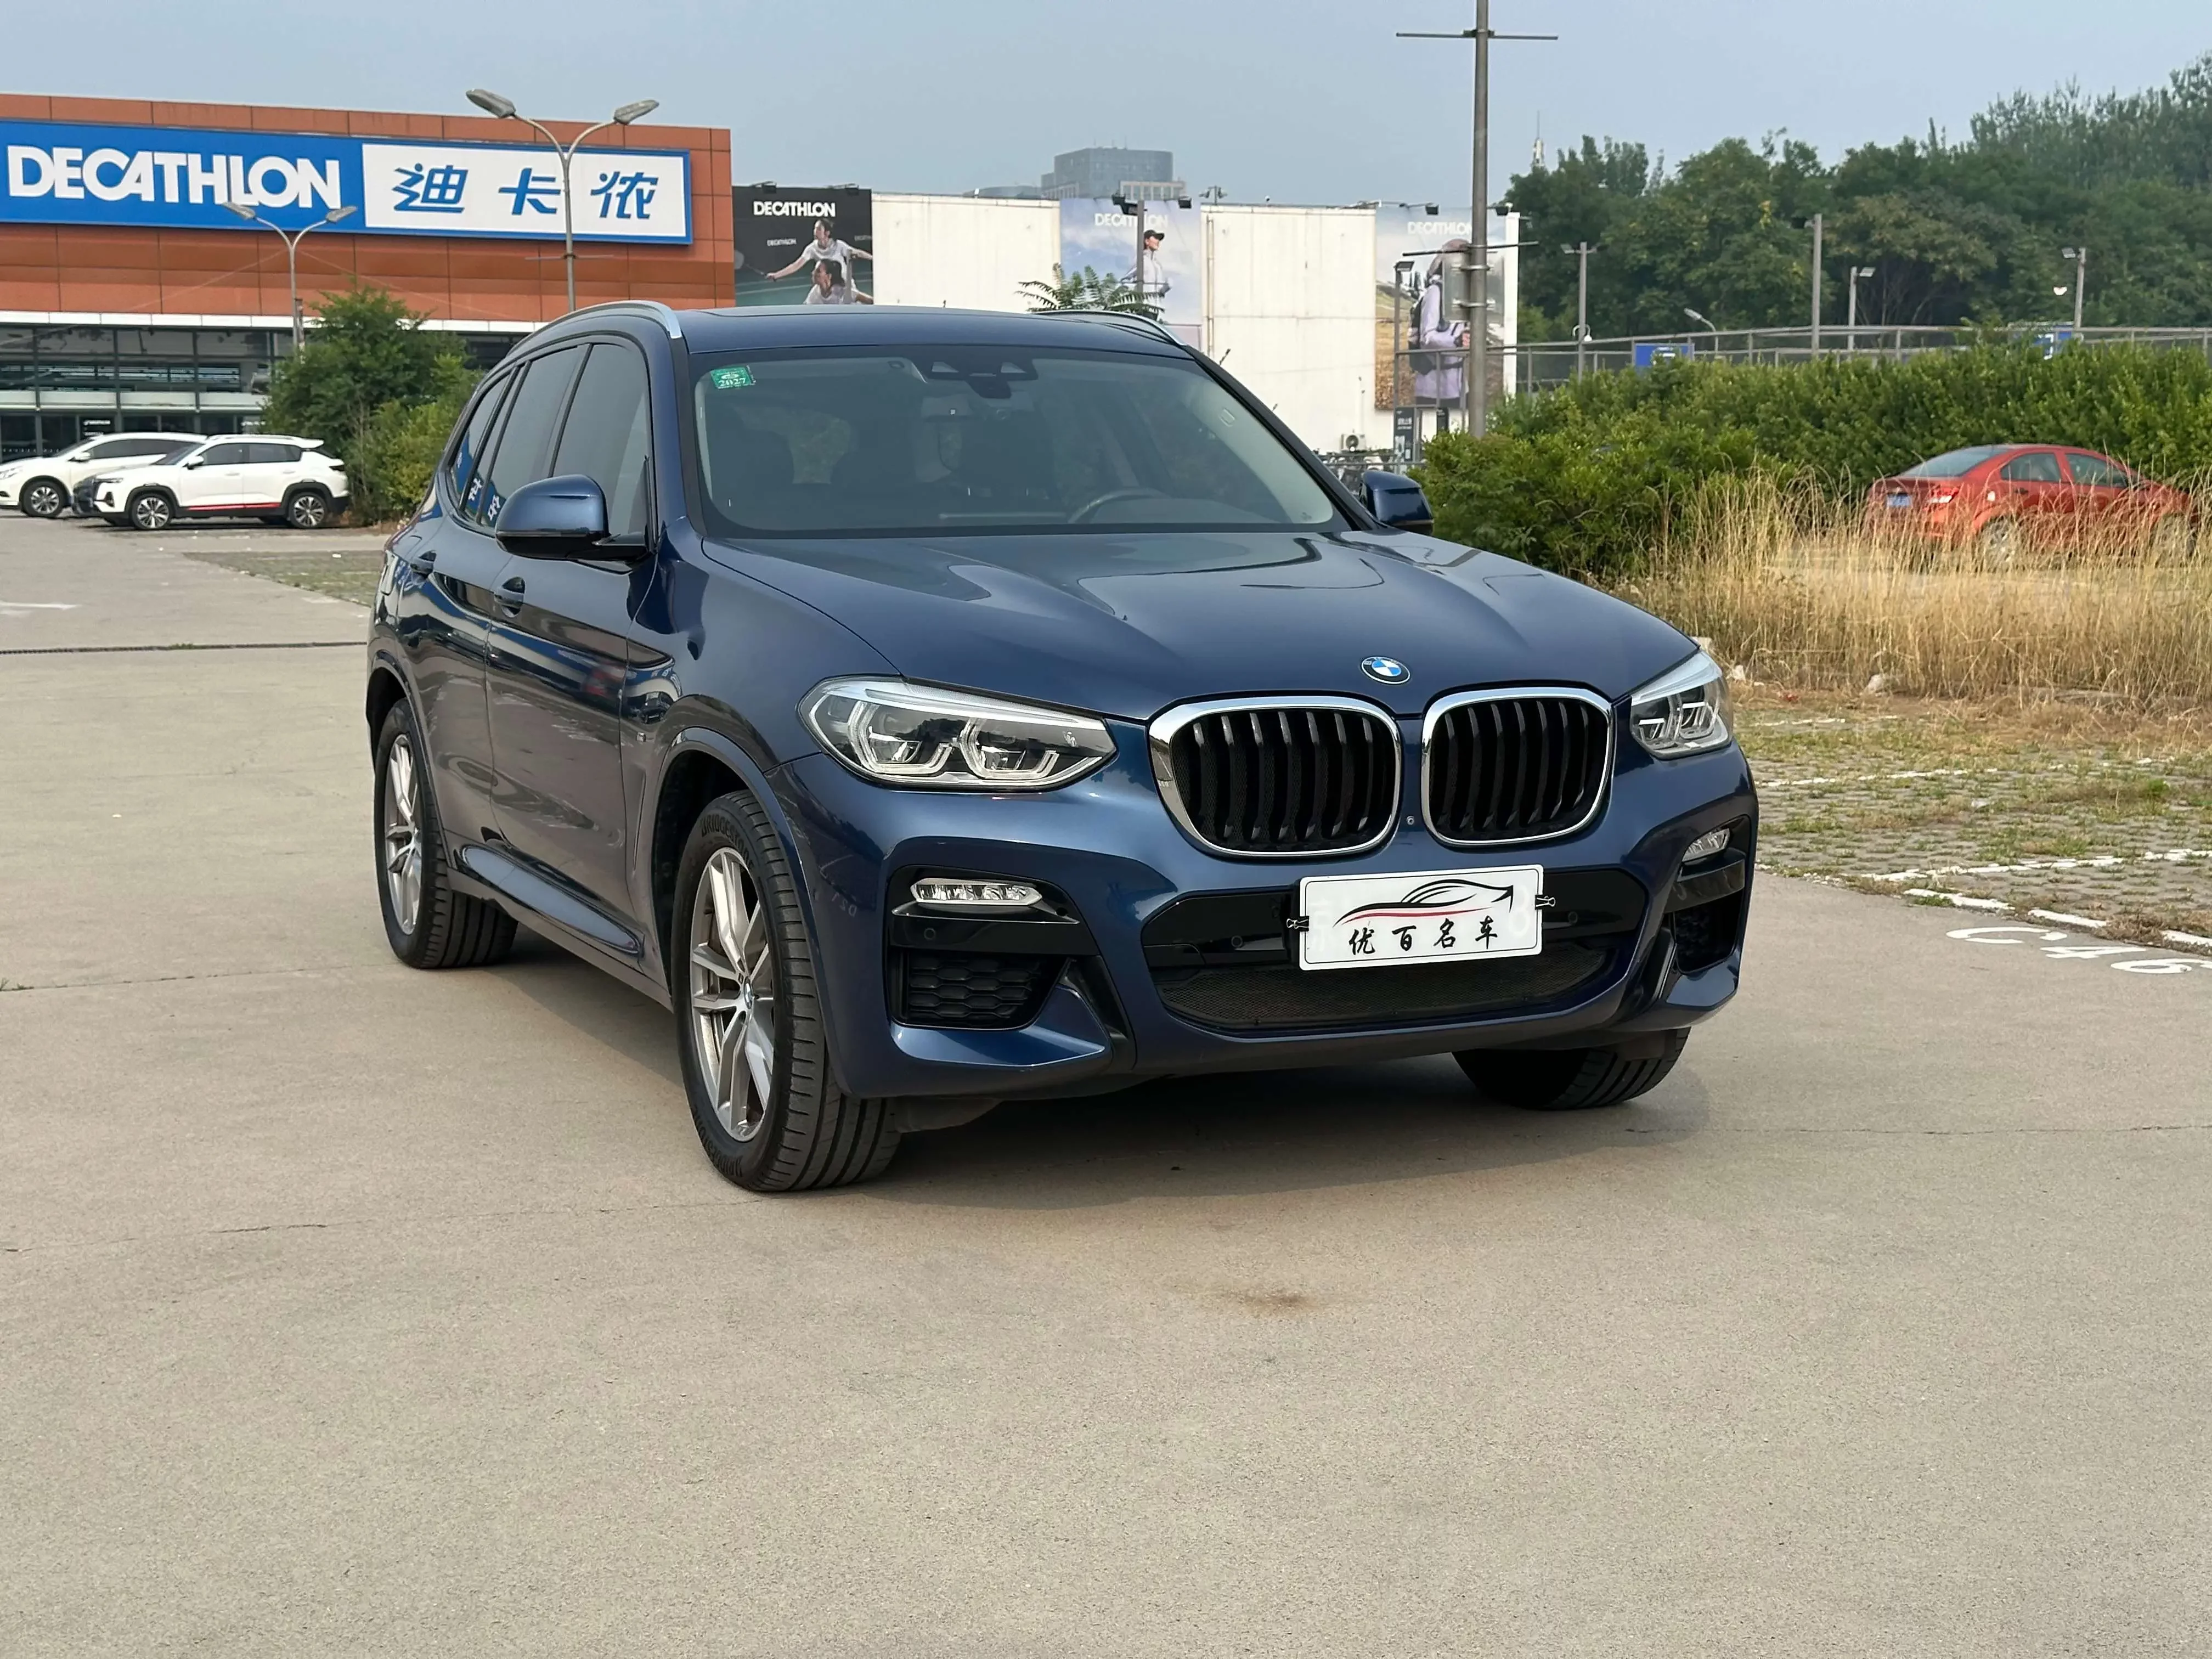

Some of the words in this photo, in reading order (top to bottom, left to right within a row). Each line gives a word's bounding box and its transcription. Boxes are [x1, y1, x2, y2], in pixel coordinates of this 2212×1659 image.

[7, 145, 341, 210] DECATHLON
[392, 163, 658, 219] 迪卡侬
[753, 200, 836, 217] DECATHLON
[718, 377, 746, 387] 2027
[1348, 916, 1498, 955] 优百名车
